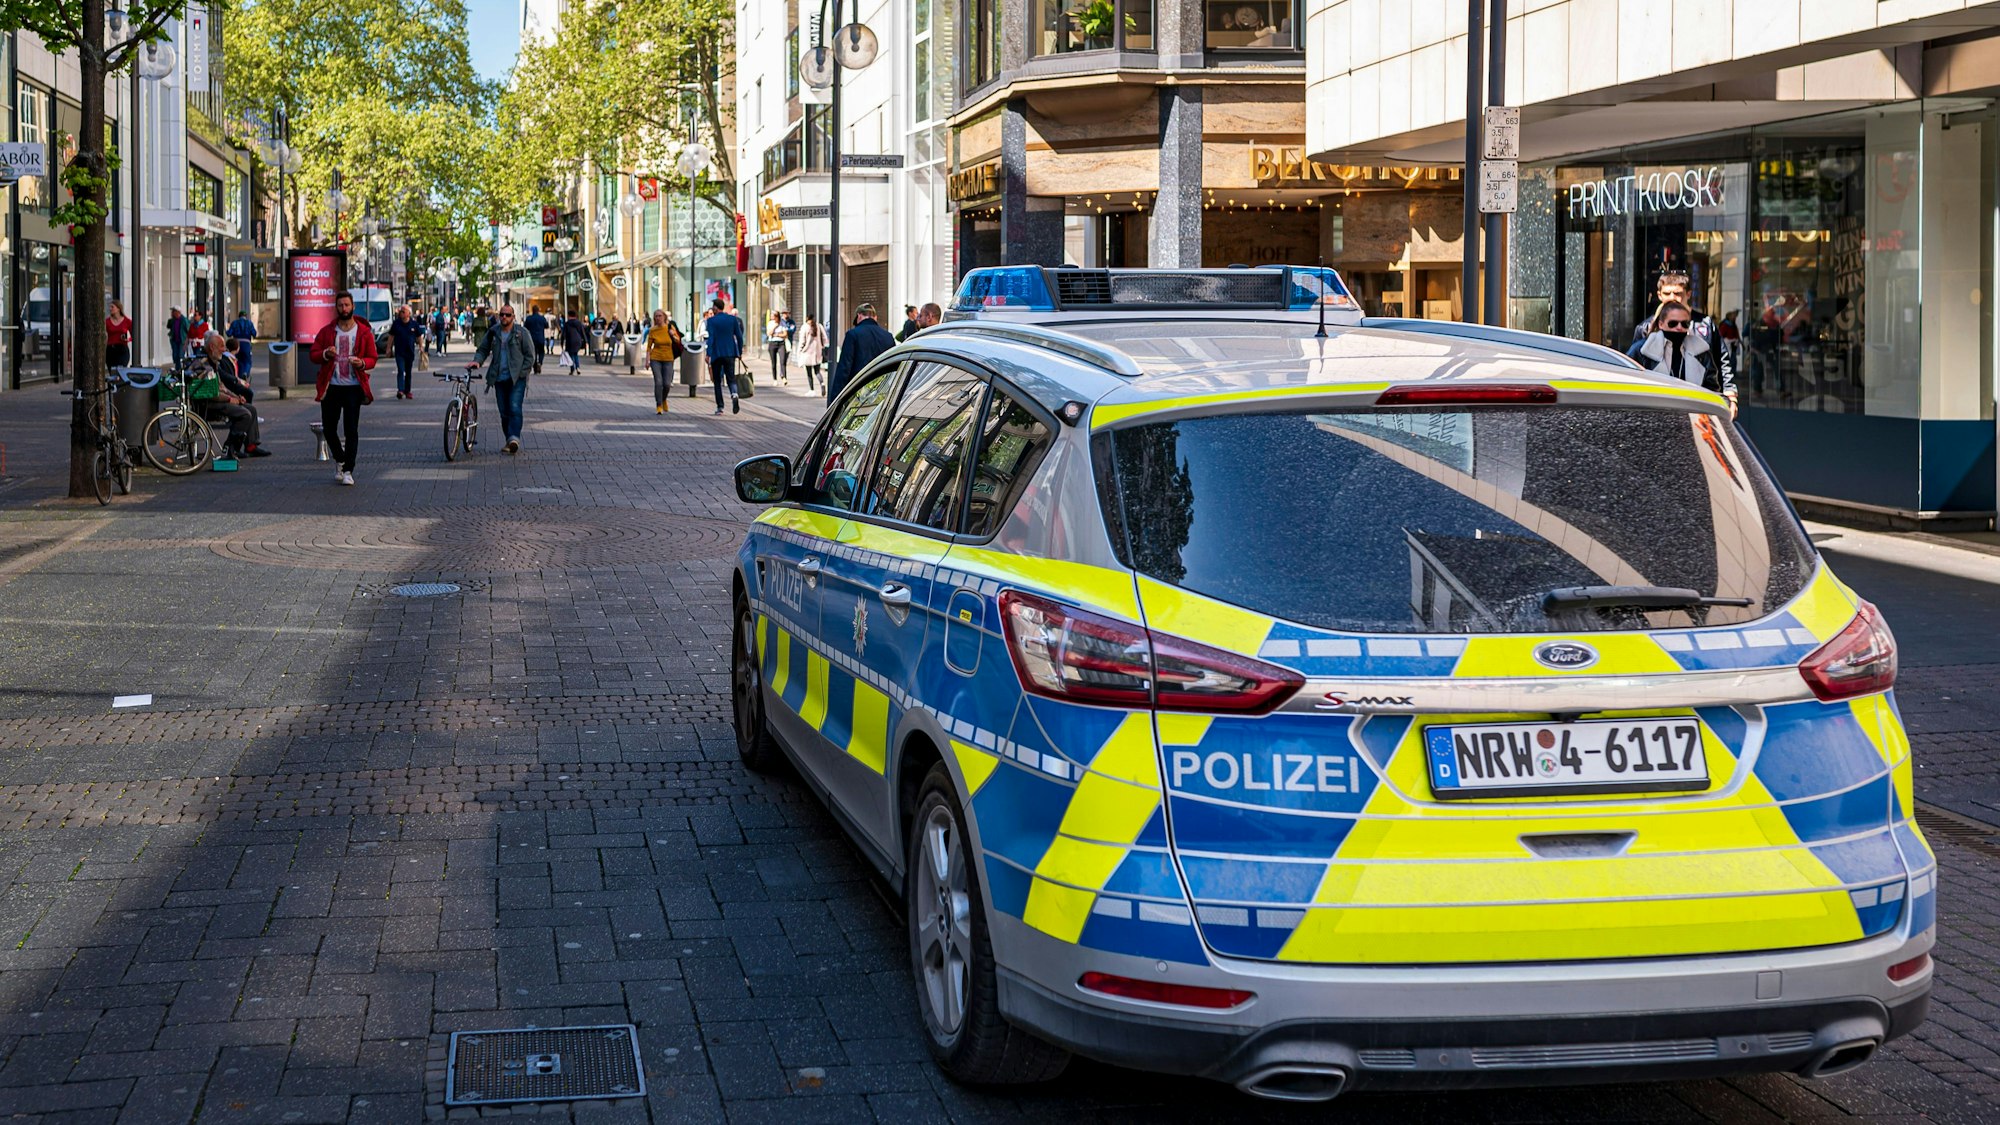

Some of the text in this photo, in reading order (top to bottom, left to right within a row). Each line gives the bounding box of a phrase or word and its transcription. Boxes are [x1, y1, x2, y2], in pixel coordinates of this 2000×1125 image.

[193, 34, 202, 83] TOMMY
[1506, 117, 1518, 125] 663
[848, 156, 898, 168] Perlengäßchen
[1502, 171, 1515, 179] 664
[1569, 175, 1636, 220] PRINT
[1638, 166, 1718, 213] KIOSK
[780, 206, 829, 218] Schildergasse
[294, 260, 319, 270] Bring
[294, 269, 330, 278] Corona
[294, 278, 319, 287] nicht
[294, 287, 336, 296] zur Oma.
[770, 559, 803, 614] POLIZEI
[1549, 646, 1583, 662] Ford
[1454, 731, 1534, 780] NRW
[1560, 725, 1698, 775] 4-6117
[1172, 751, 1360, 794] POLIZEI
[1439, 763, 1451, 778] D
